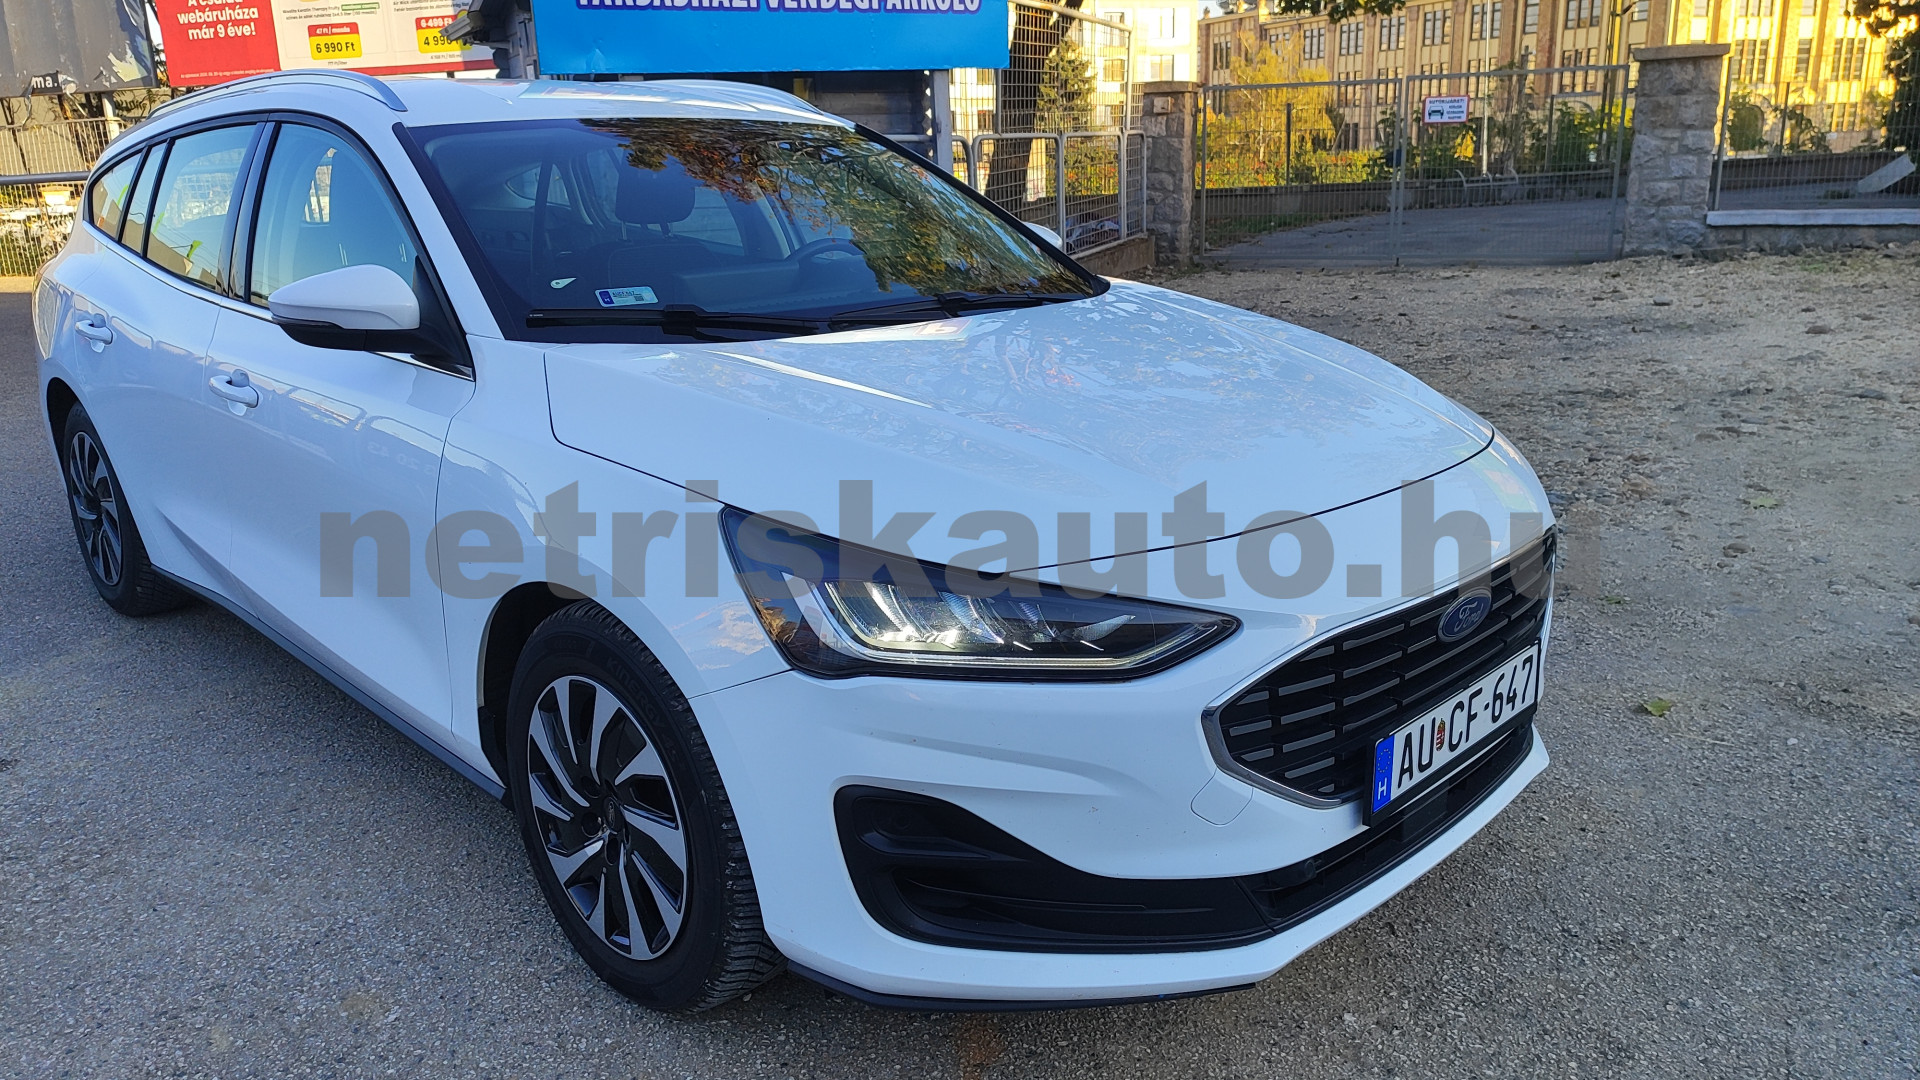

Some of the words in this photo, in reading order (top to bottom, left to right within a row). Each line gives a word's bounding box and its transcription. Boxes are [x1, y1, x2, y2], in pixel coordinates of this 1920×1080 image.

[177, 5, 259, 24] webáruháza
[420, 18, 427, 28] 6
[188, 24, 215, 40] már
[216, 23, 226, 38] 9
[227, 22, 256, 37] éve!
[316, 43, 322, 53] 6
[324, 42, 343, 53] 990
[345, 41, 355, 52] Ft
[423, 36, 430, 46] 4
[1453, 602, 1484, 634] Ford
[1397, 715, 1436, 789] AU
[1448, 653, 1534, 753] CF-647
[1377, 778, 1388, 801] H
